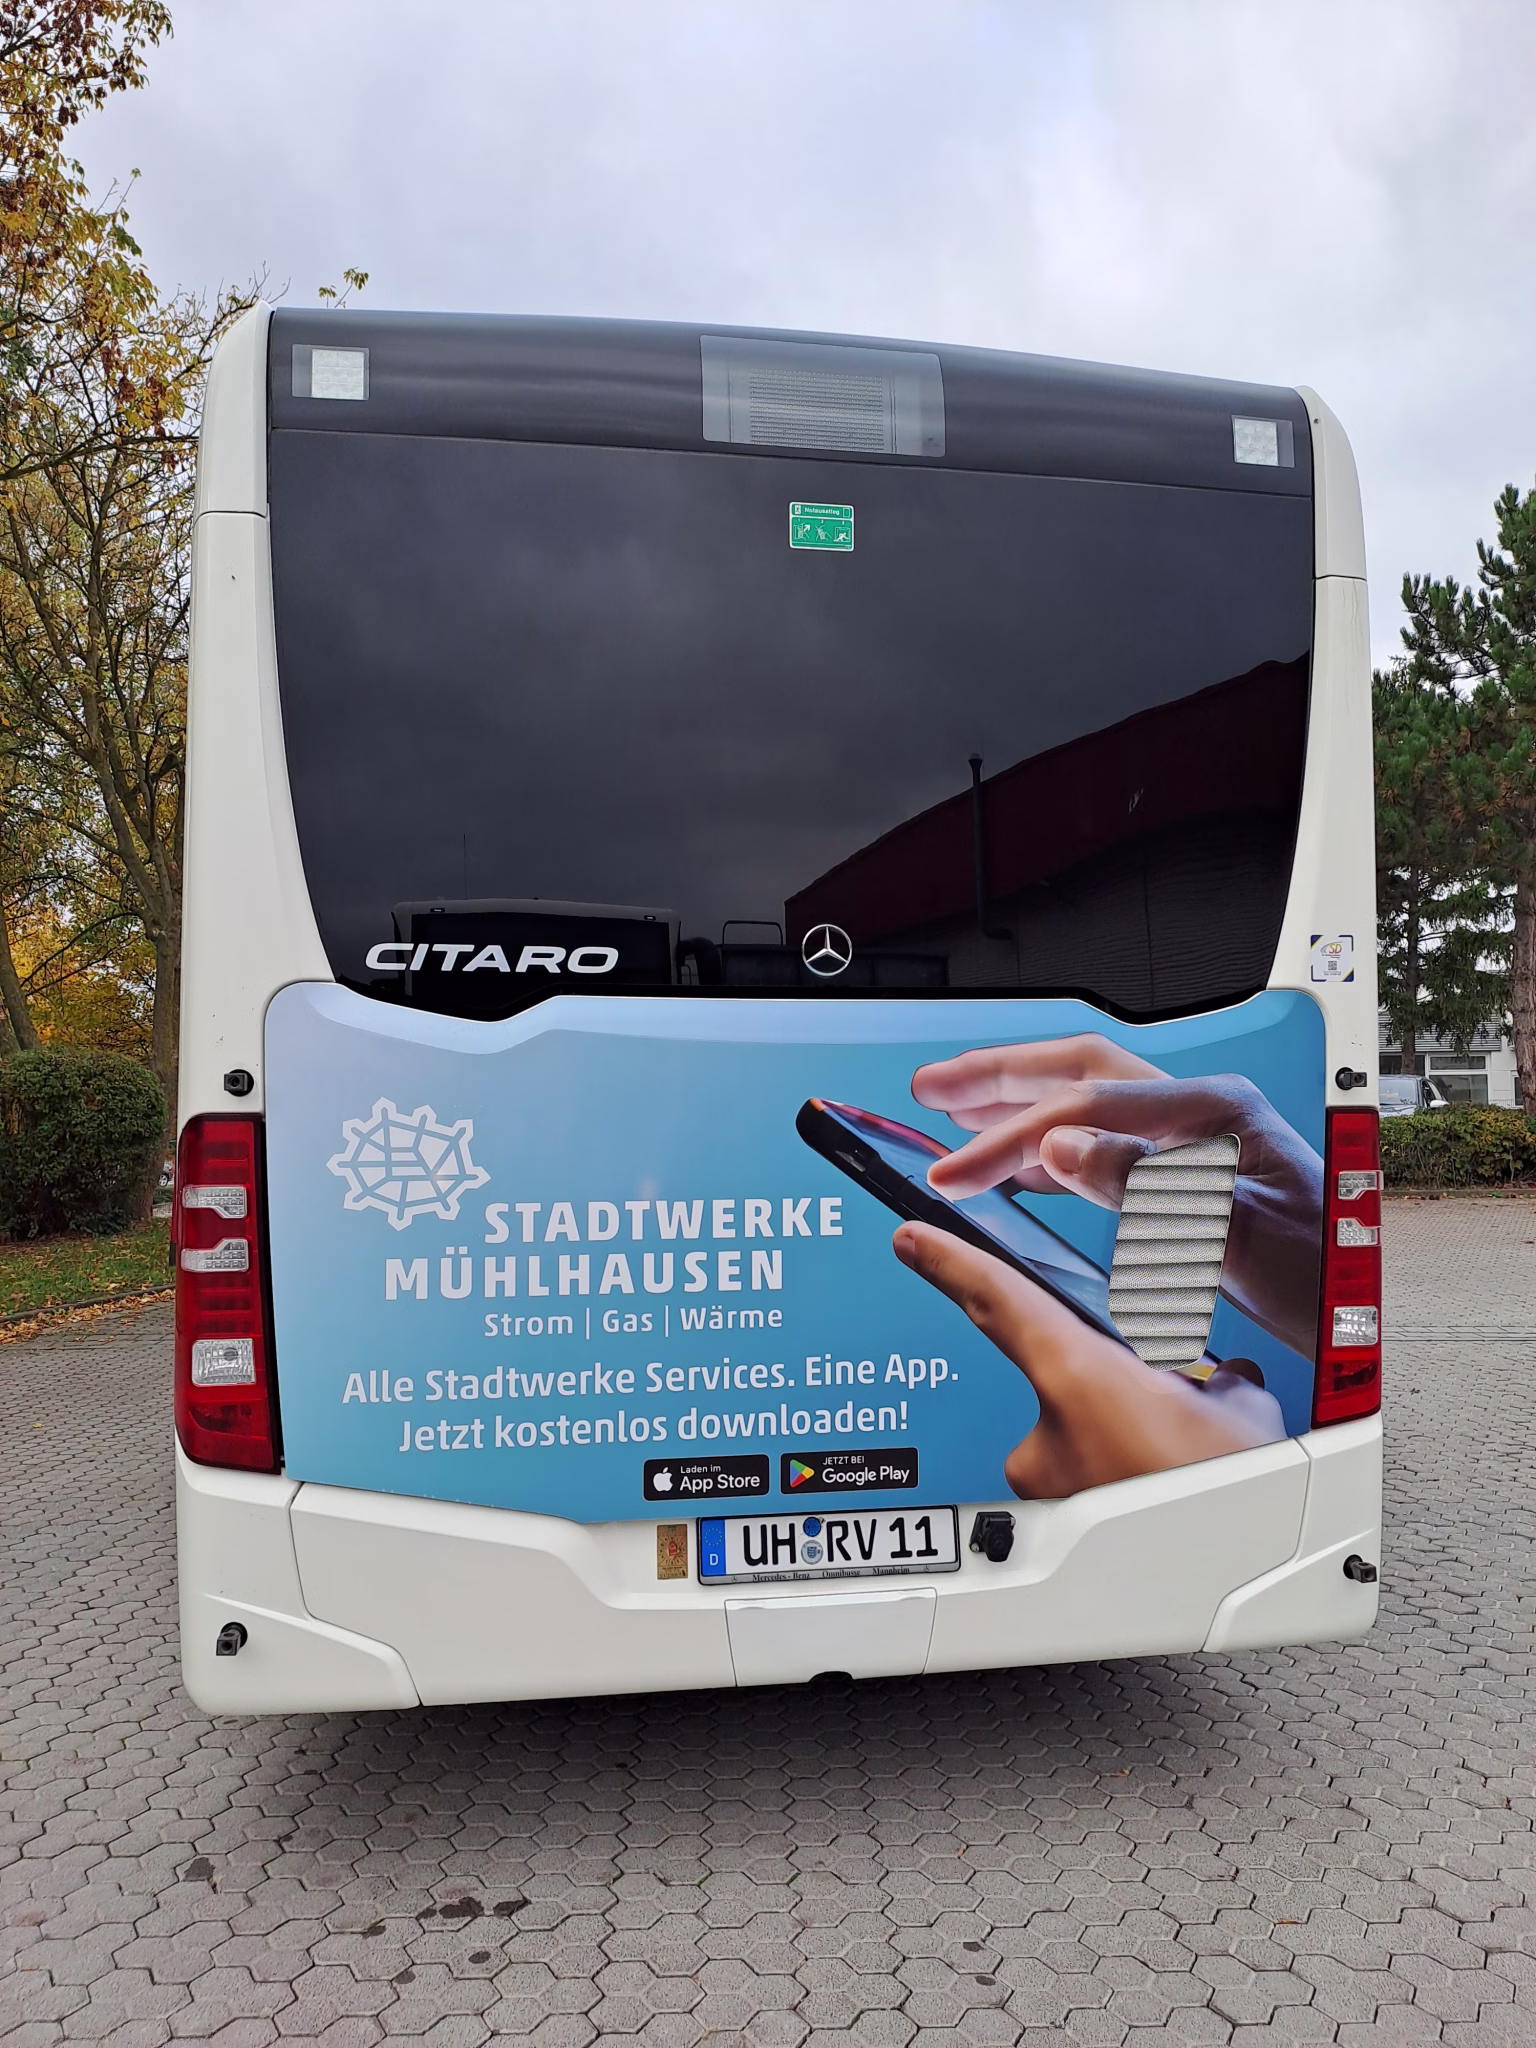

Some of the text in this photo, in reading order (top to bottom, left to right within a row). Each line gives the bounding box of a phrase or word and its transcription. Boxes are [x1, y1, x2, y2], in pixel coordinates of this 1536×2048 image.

[365, 942, 619, 974] CITARO
[483, 1196, 845, 1244] STADTWERKE
[384, 1246, 784, 1301] MÜHLHAUSEN
[483, 1312, 575, 1338] Strom
[602, 1309, 654, 1334] Gas
[680, 1306, 784, 1332] Wärme
[342, 1353, 960, 1405] Alle Stadtwerke Services. Eine App.
[399, 1400, 909, 1452] Jetzt kostenlos downloaden!
[680, 1464, 722, 1475] Laden im
[822, 1455, 865, 1466] JETZT BEI
[822, 1465, 911, 1486] Google Play
[679, 1473, 761, 1493] App Store
[743, 1516, 938, 1566] UH RV 11
[709, 1553, 719, 1566] D
[822, 1569, 861, 1579] Omnibusse
[872, 1566, 911, 1576] Mannheim
